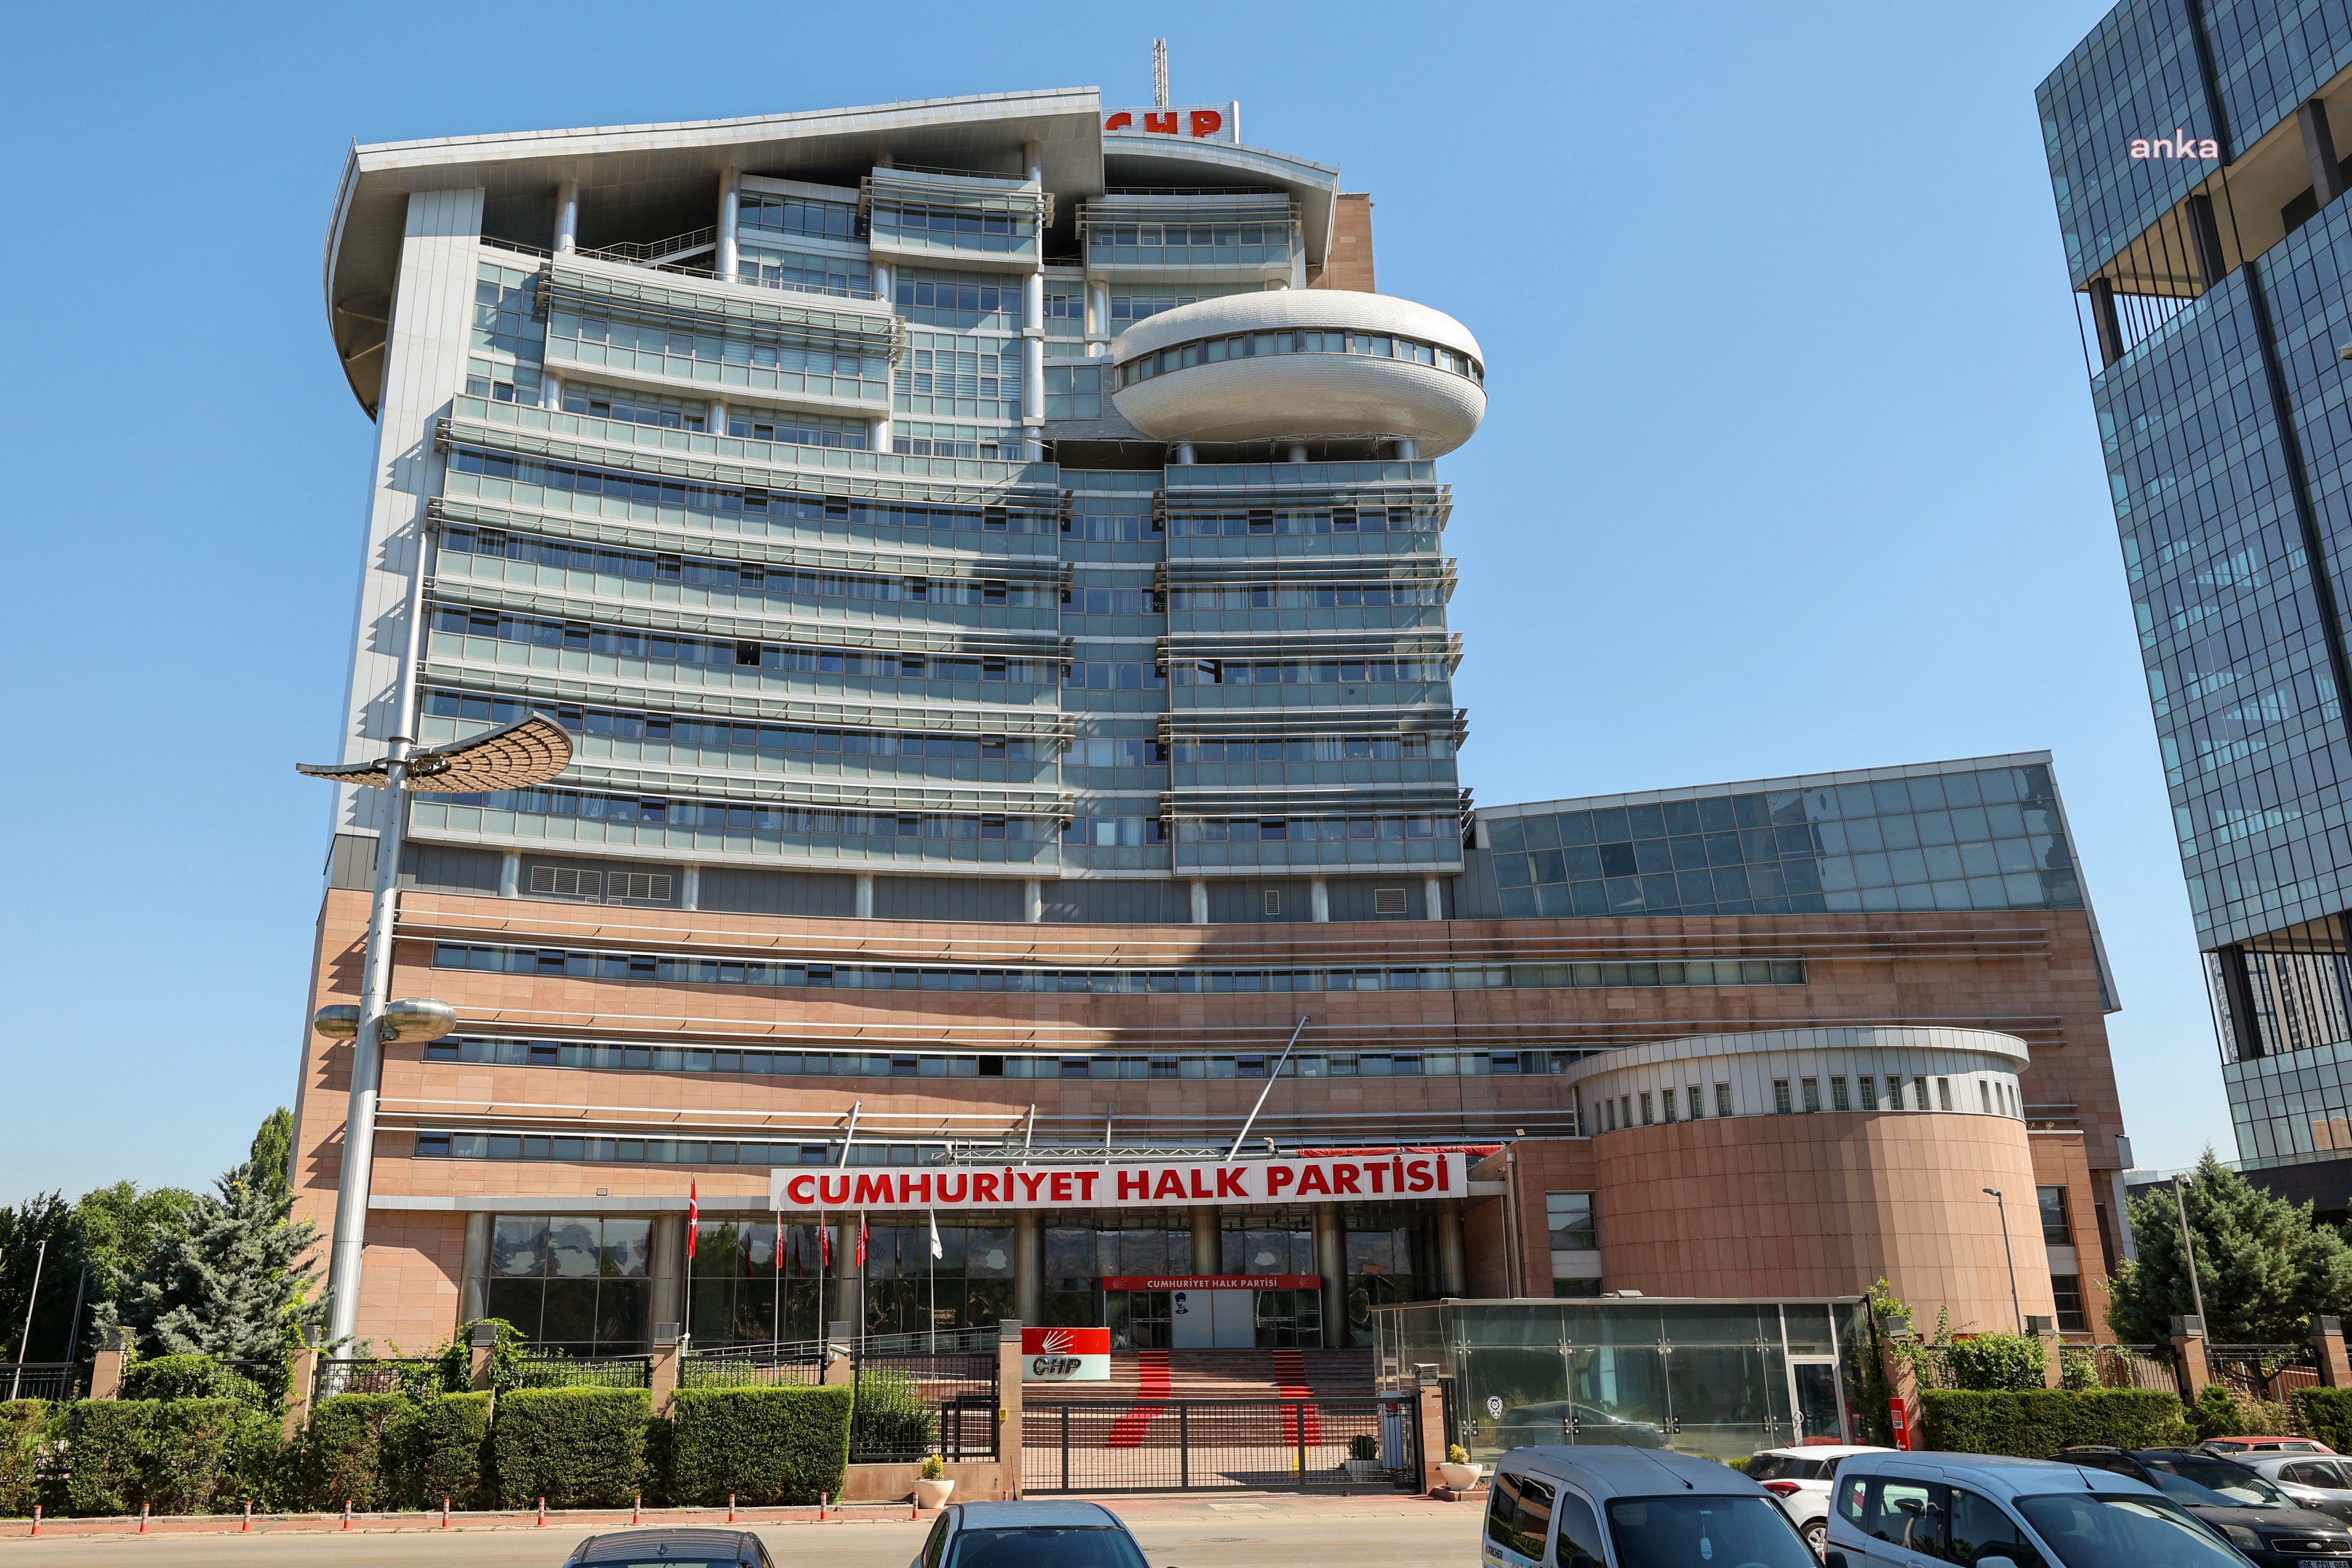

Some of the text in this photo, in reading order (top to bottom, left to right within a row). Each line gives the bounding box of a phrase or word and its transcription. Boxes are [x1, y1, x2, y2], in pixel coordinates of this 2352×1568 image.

[1105, 111, 1221, 138] CHP
[787, 1154, 1449, 1205] CUMHURİYET HALK PARTİSİ
[1148, 1278, 1209, 1288] CUMHURİYET
[1241, 1277, 1277, 1287] PARTİSİ
[1033, 1357, 1082, 1376] CHP
